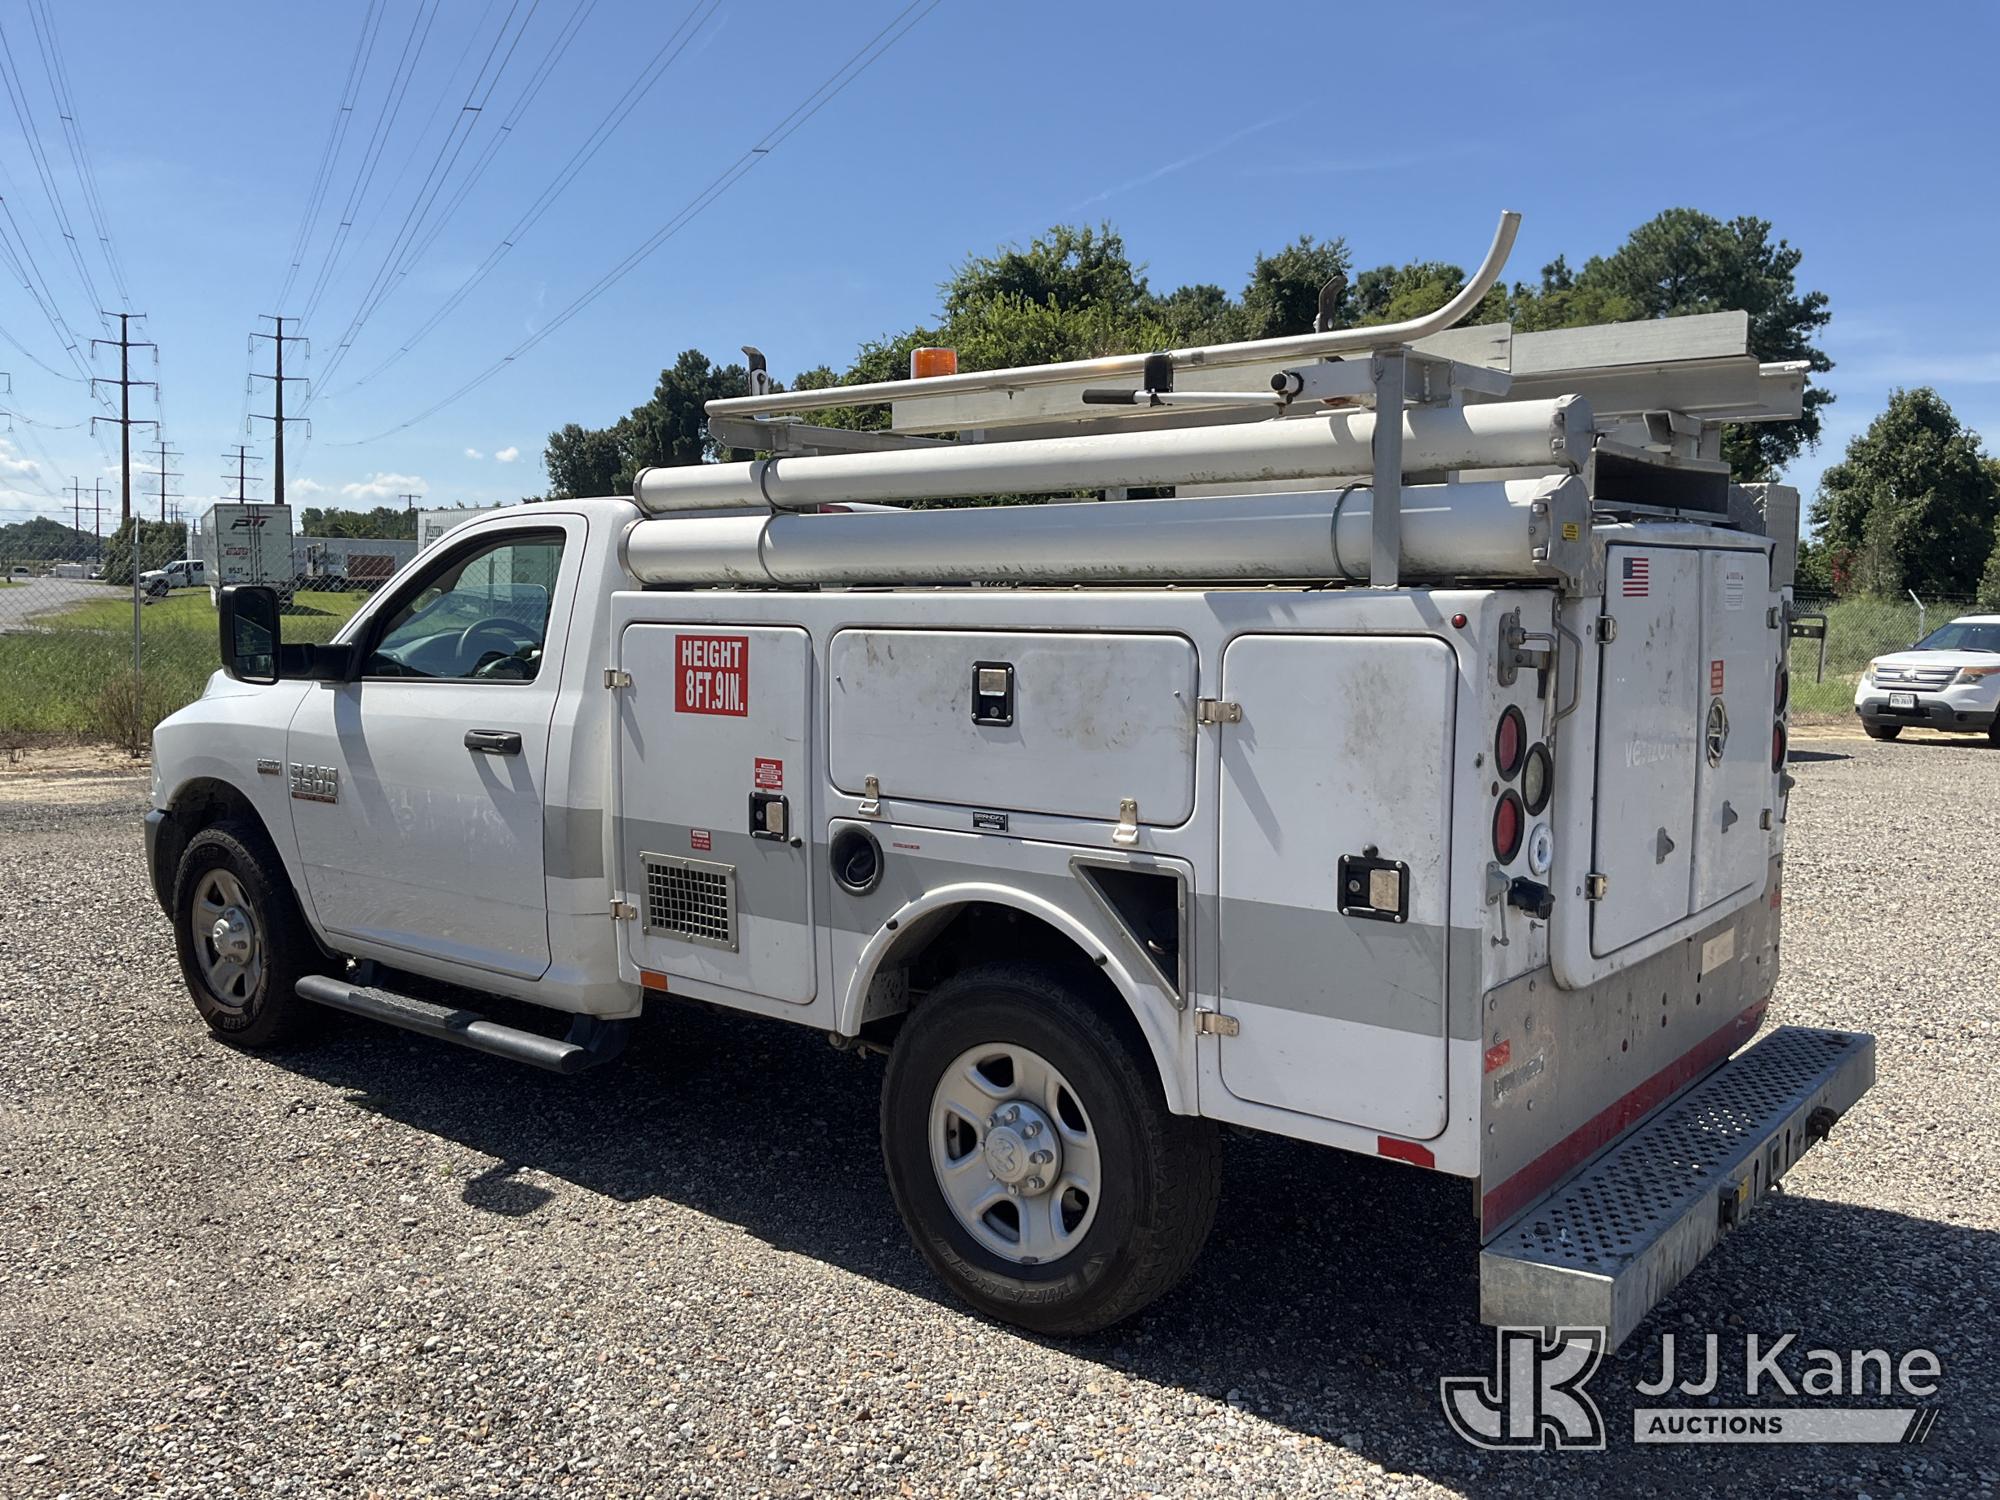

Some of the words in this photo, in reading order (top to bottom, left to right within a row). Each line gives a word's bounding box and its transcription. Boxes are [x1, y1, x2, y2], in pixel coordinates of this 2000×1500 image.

[681, 640, 742, 668] HEIGHT
[685, 669, 744, 711] 8FT.9IN.
[290, 762, 337, 781] RAM
